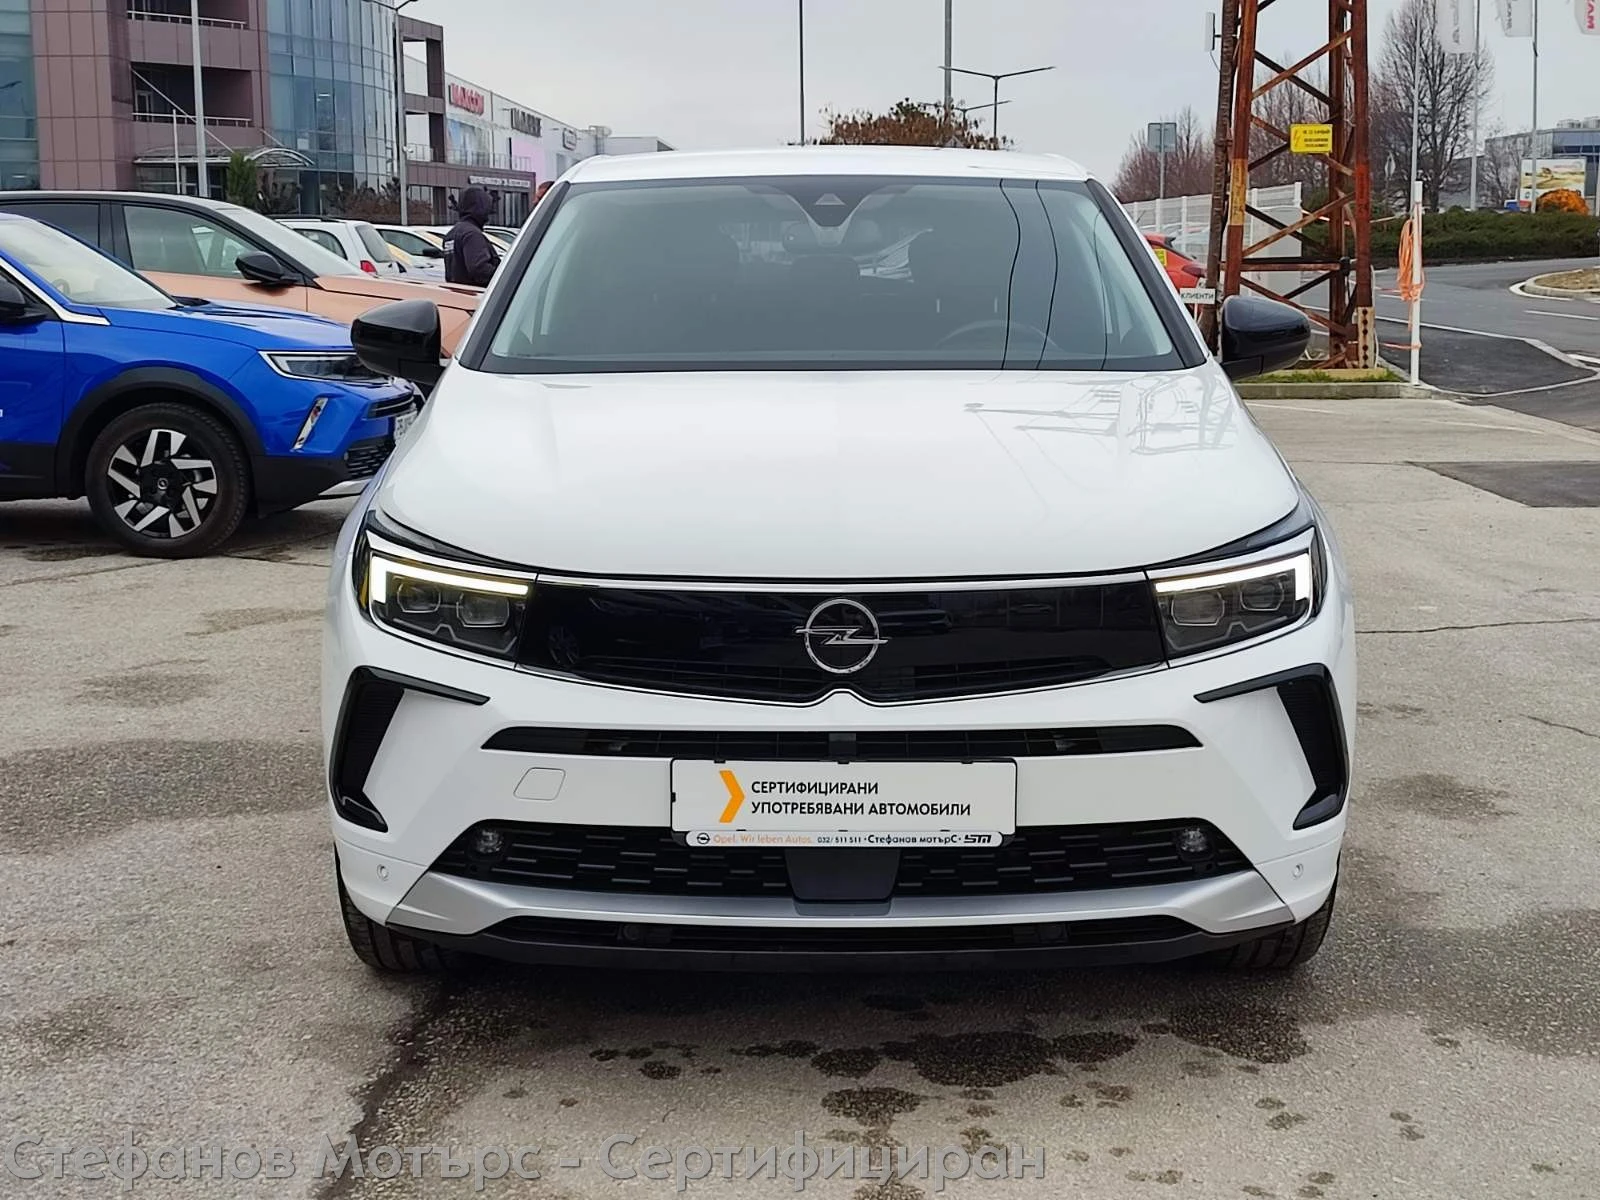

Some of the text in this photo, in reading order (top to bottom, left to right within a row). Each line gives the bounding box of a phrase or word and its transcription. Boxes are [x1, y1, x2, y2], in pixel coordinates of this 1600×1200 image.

[752, 781, 878, 796] СЕРТИФИЦИРАНИ
[752, 802, 970, 816] УПОТРЕБЯВАНИ АВТОМОБИЛИ
[758, 834, 783, 844] leben
